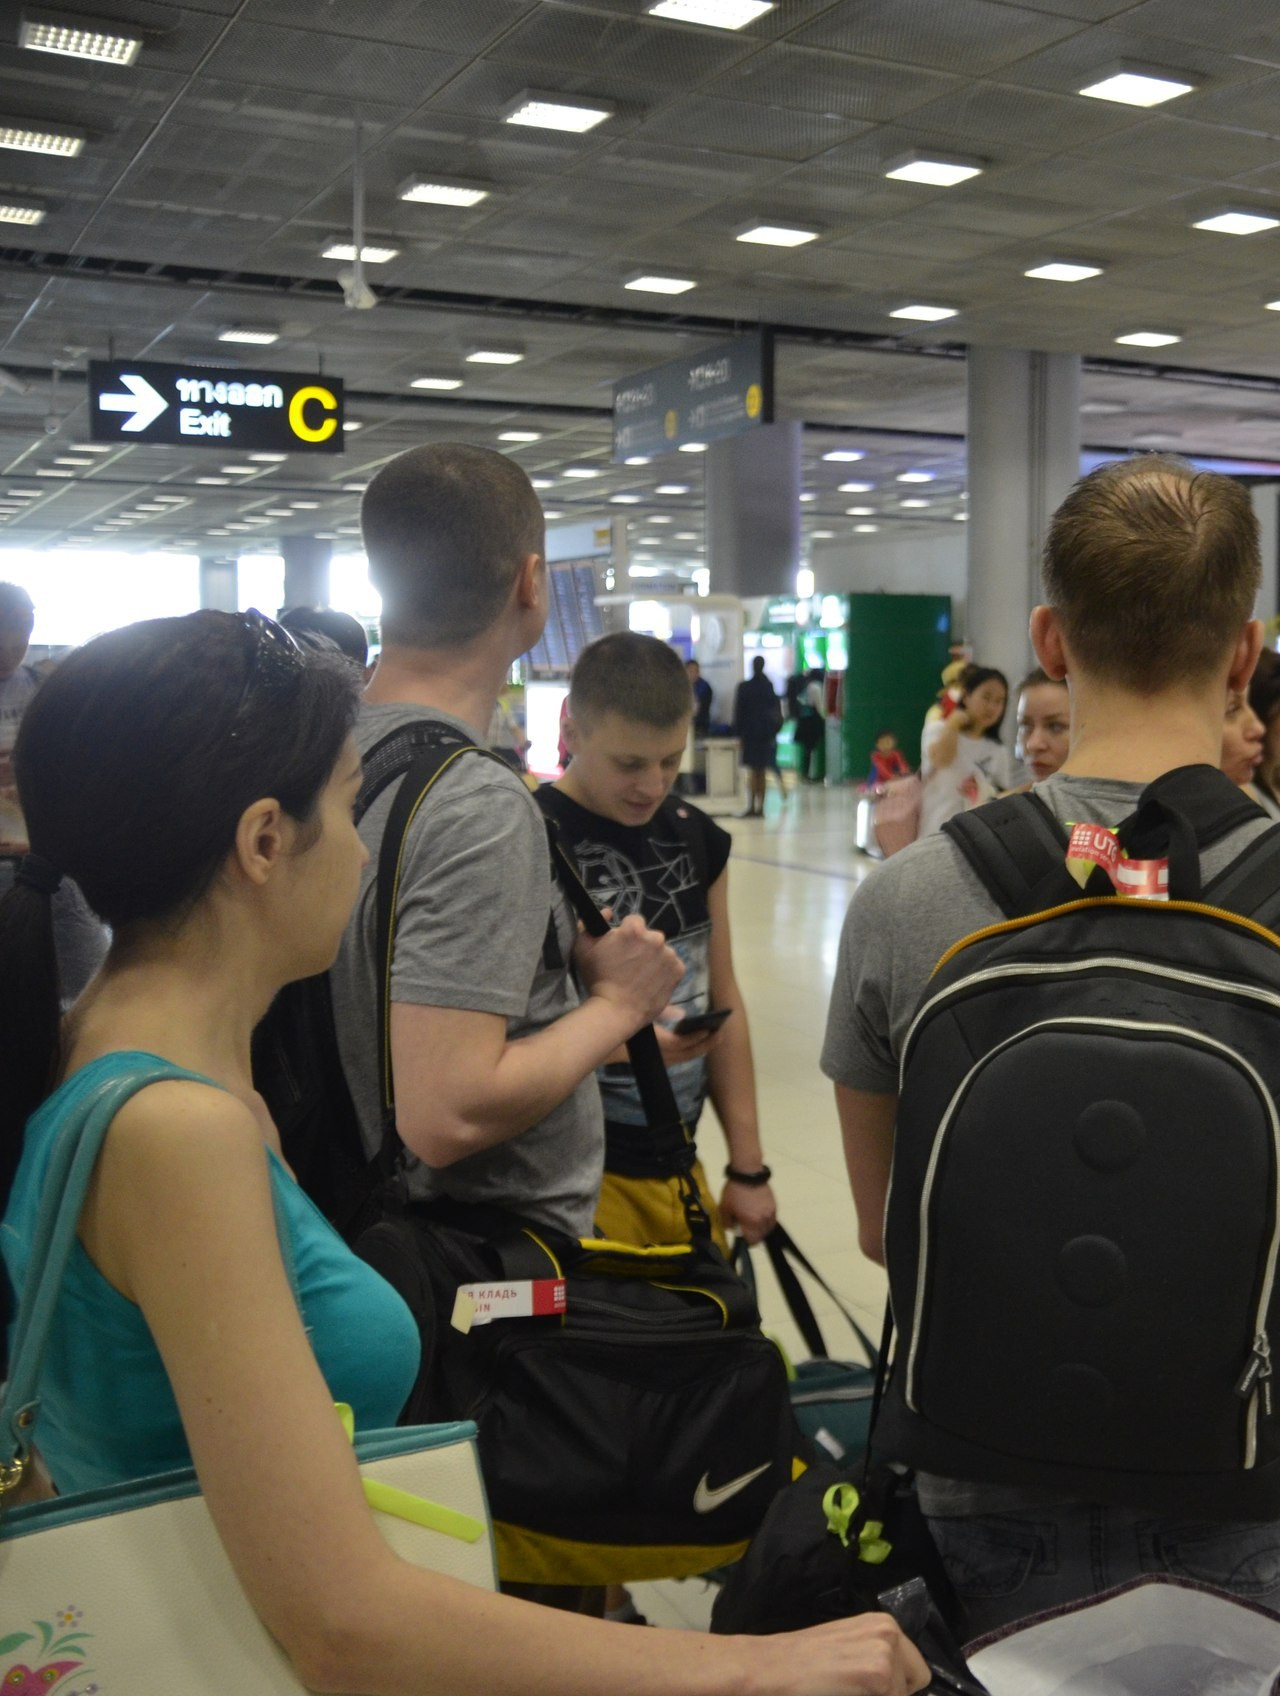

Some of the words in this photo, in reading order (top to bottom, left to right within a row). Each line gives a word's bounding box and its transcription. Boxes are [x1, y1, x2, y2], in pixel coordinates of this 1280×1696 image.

[180, 407, 232, 437] Exit
[288, 385, 338, 443] C
[478, 1289, 518, 1300] КЛАДЬ
